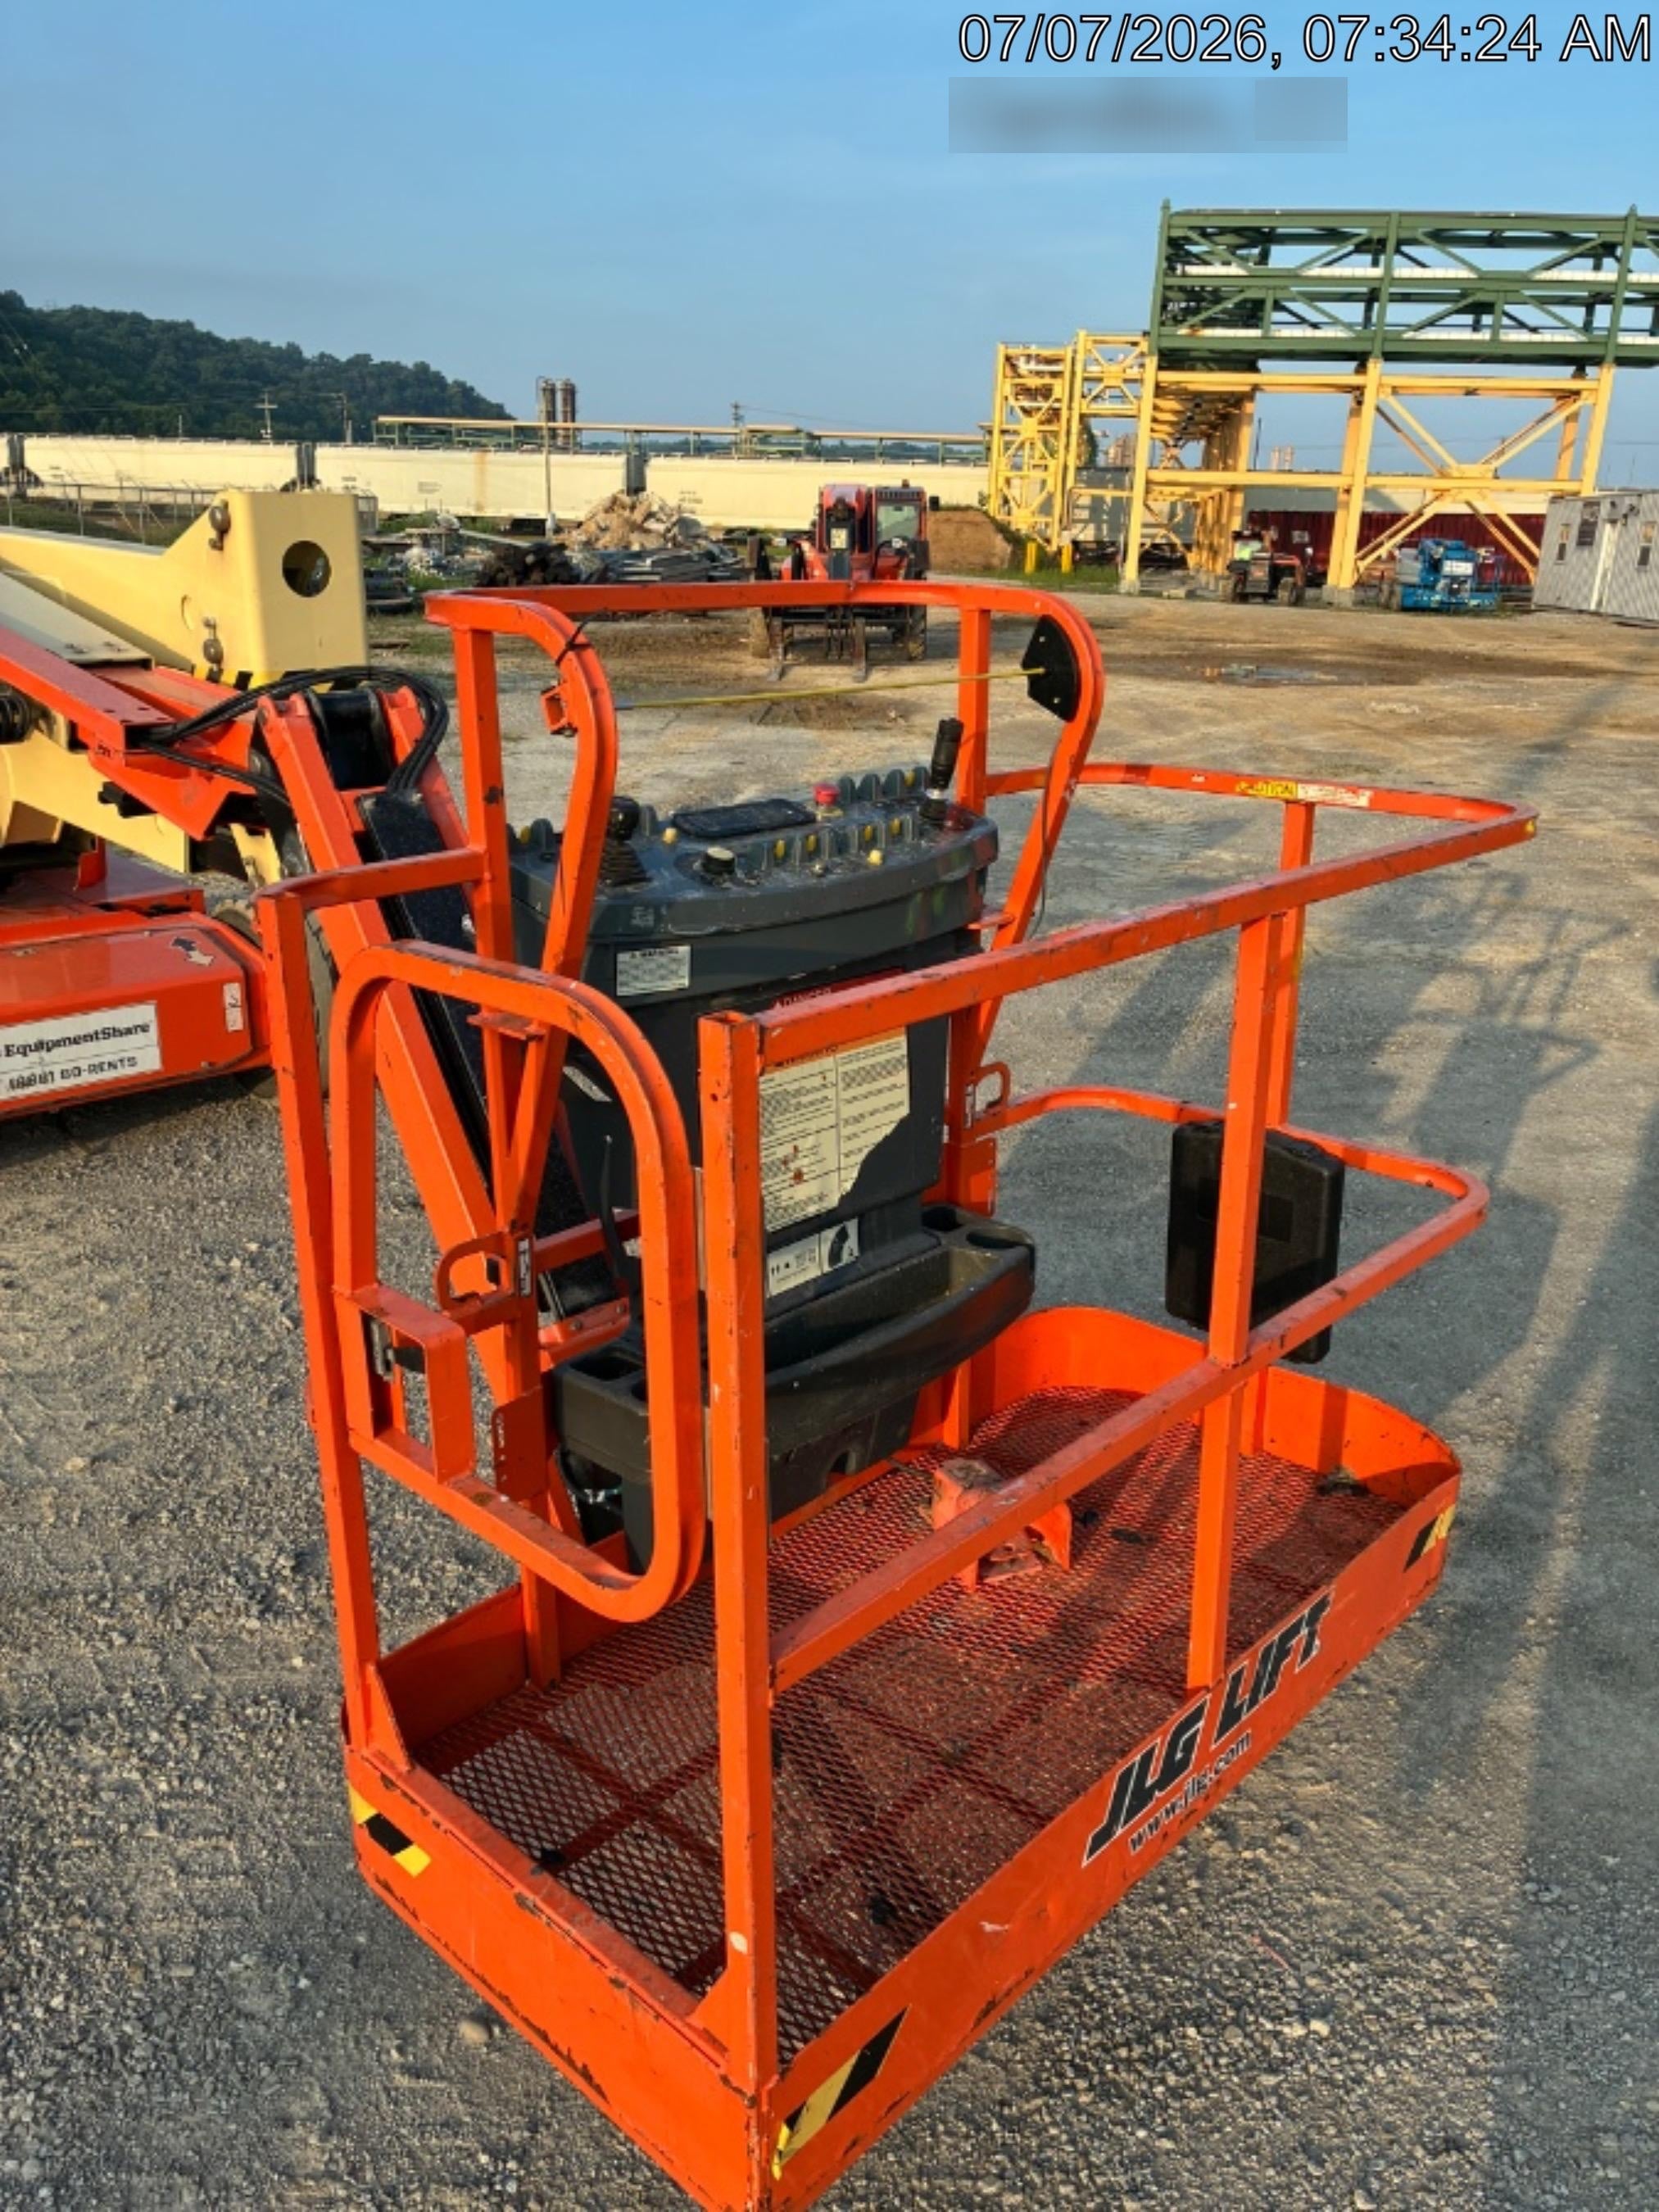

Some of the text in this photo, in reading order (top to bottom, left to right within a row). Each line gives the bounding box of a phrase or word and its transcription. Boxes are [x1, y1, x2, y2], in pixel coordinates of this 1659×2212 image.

[4, 1023, 150, 1057] EquipmentShare
[1081, 1586, 1335, 1869] JLG LIFT
